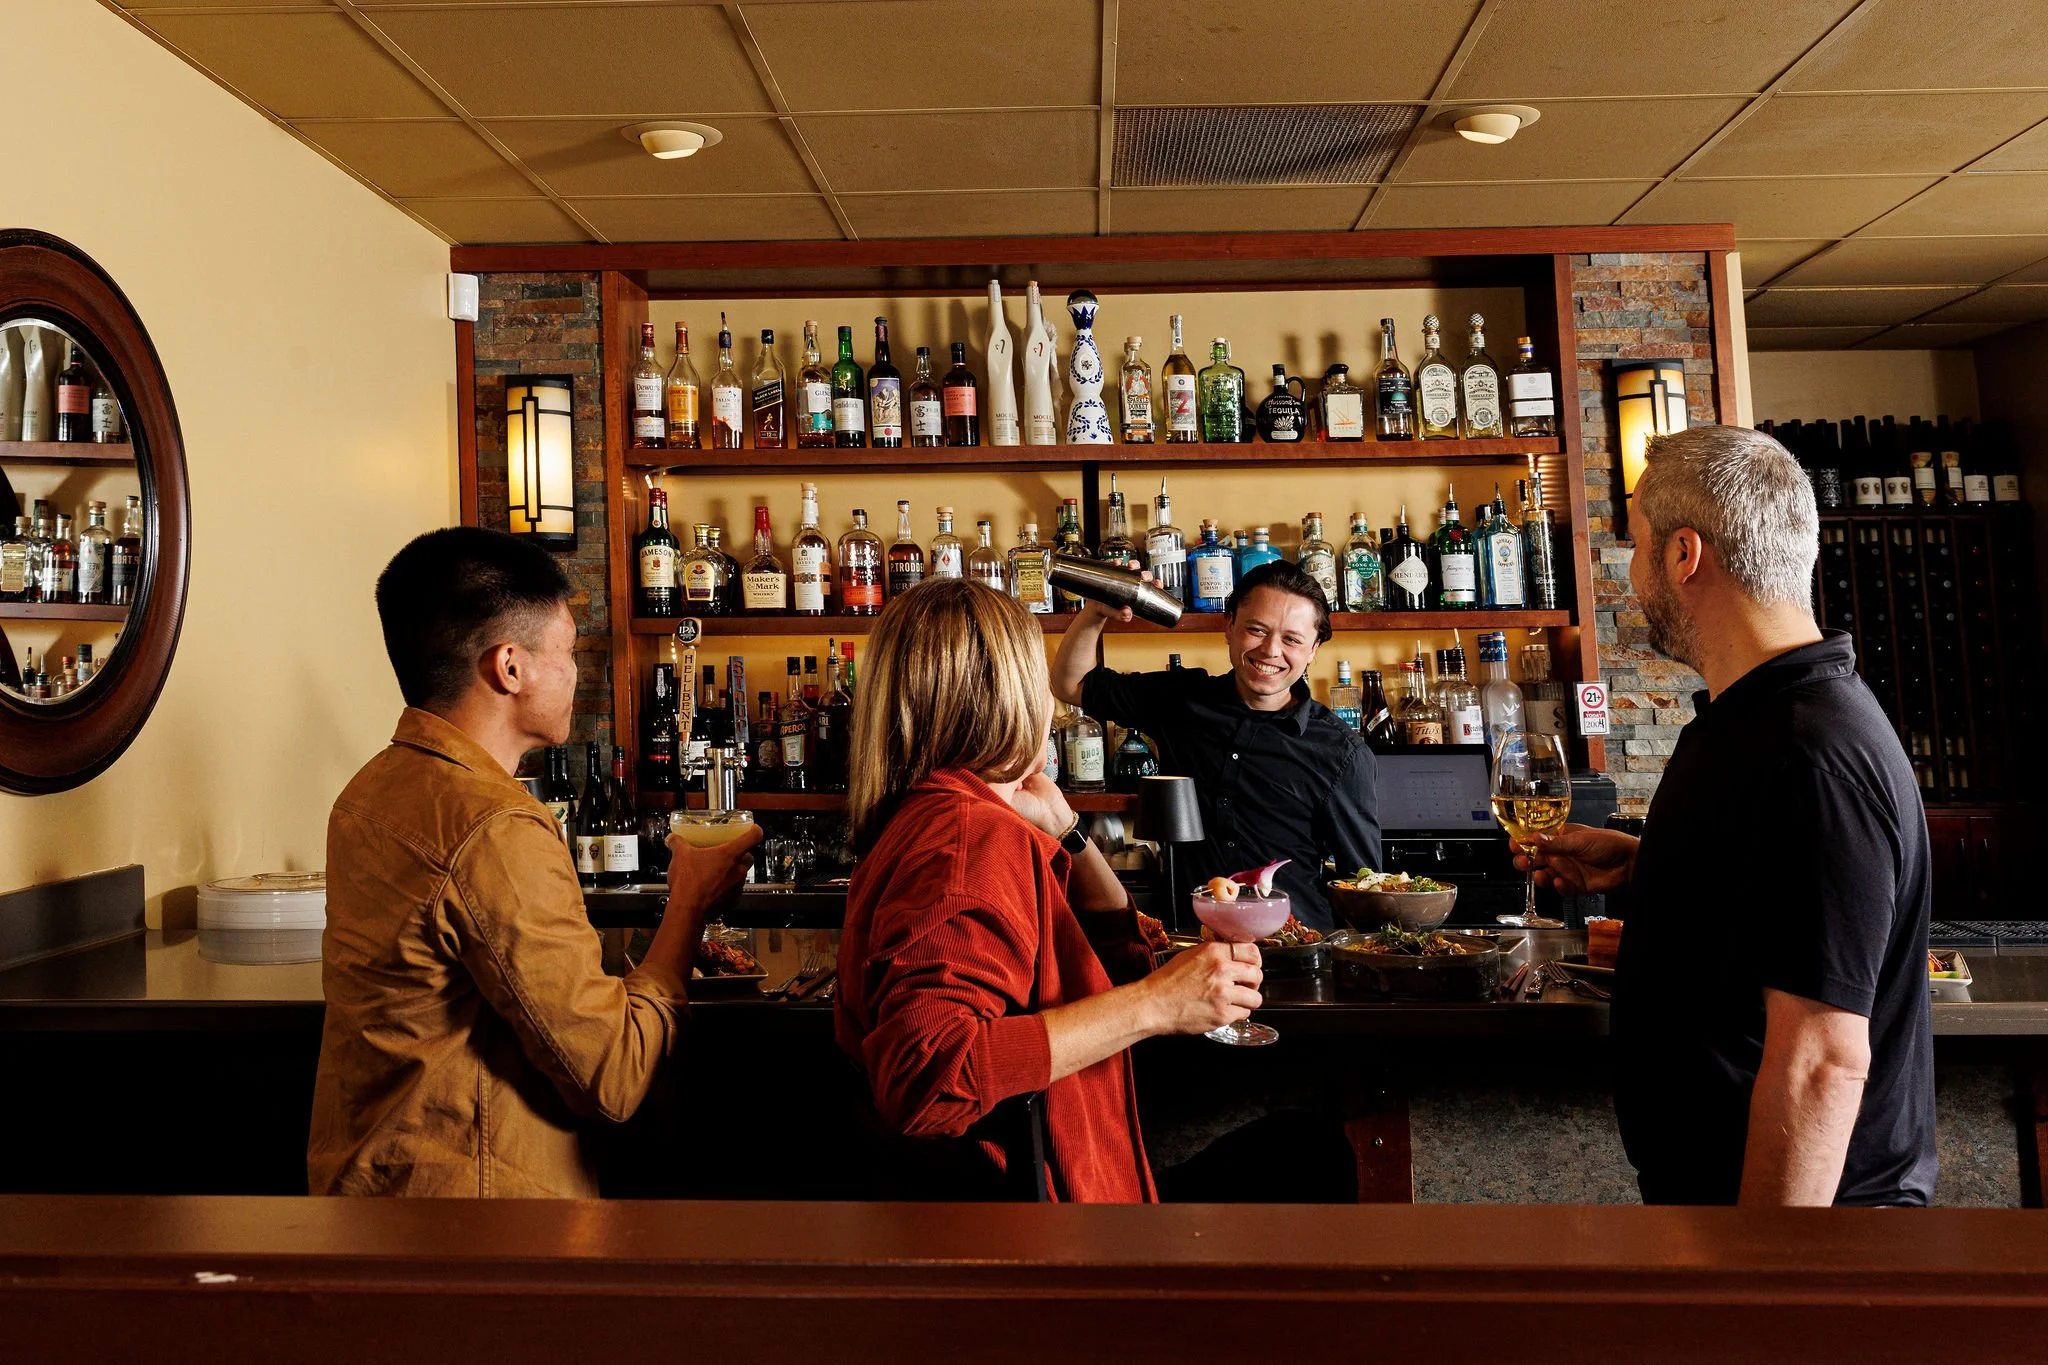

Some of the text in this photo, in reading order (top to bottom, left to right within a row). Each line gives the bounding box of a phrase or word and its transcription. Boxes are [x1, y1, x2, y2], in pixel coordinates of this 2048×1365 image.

[1174, 391, 1191, 414] 2
[1268, 407, 1300, 415] TEQUILA
[640, 548, 673, 559] JAMESON
[755, 582, 780, 590] Mark
[678, 626, 696, 635] IPA
[681, 654, 694, 731] HELLBENT
[1586, 692, 1602, 703] 21+
[780, 723, 807, 735] APEROL
[1415, 725, 1440, 736] Tito's
